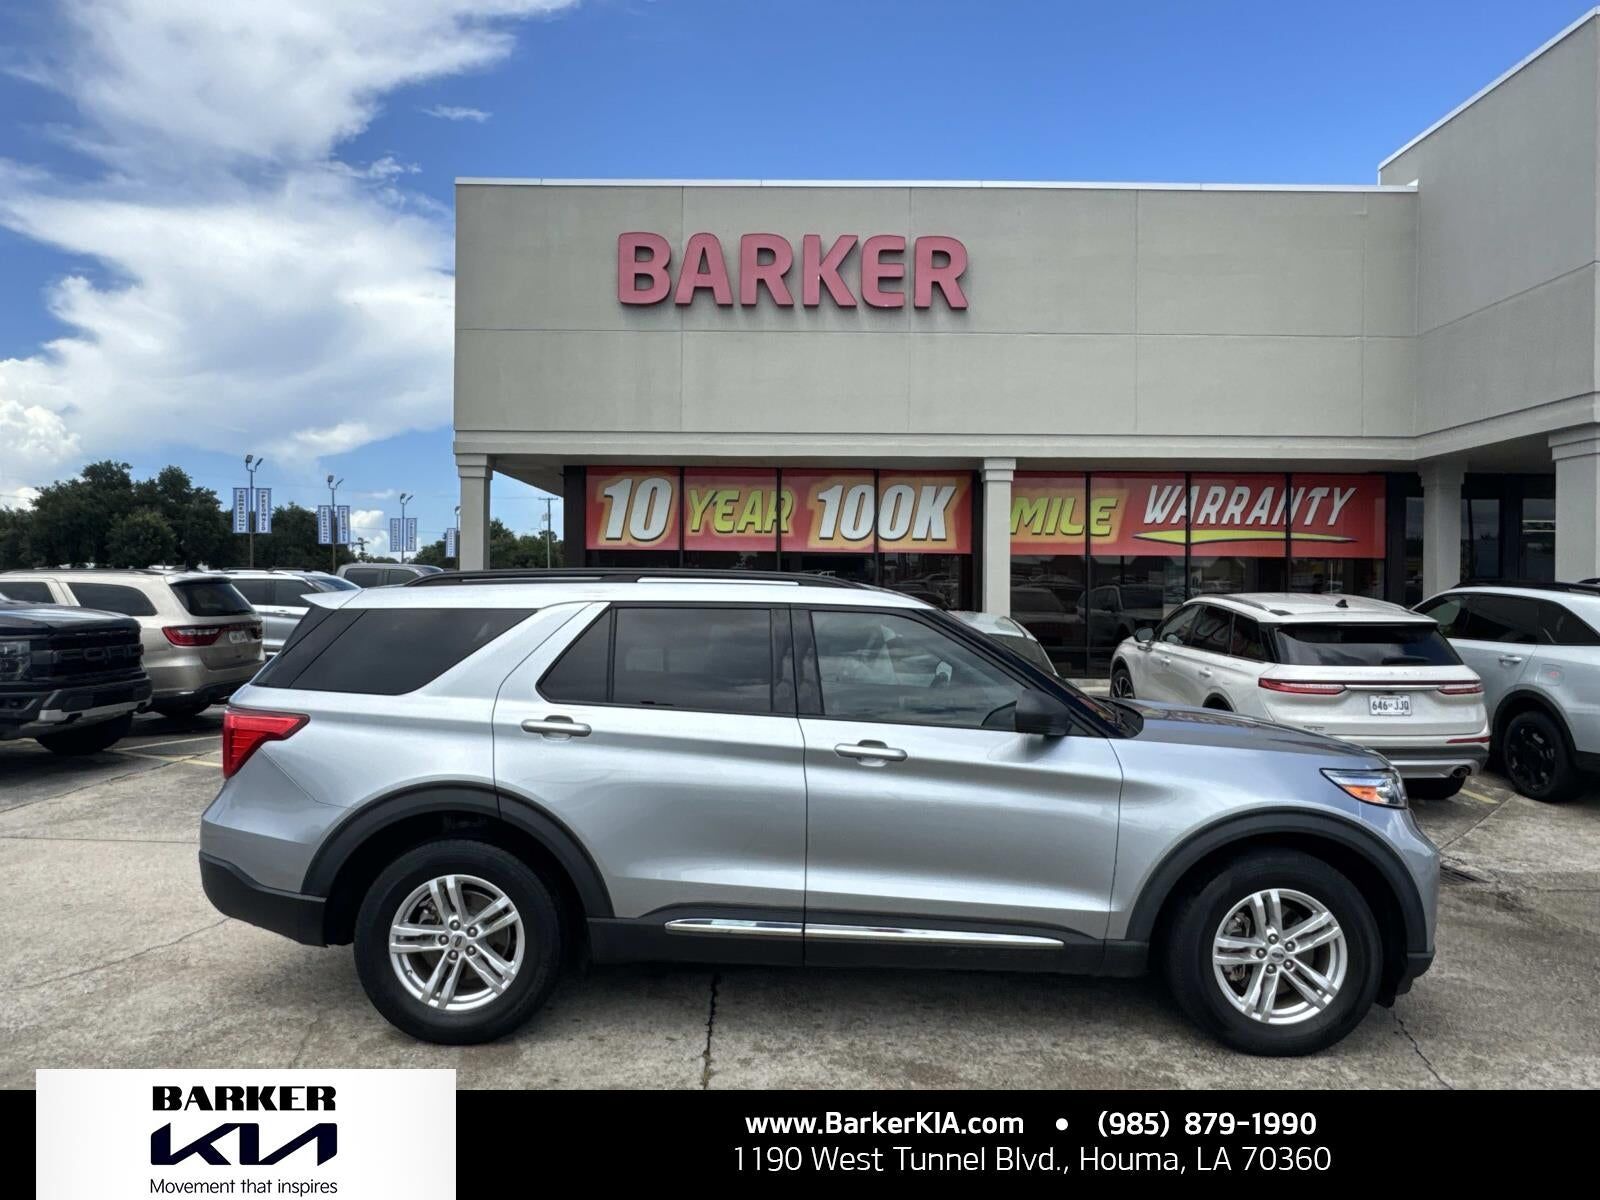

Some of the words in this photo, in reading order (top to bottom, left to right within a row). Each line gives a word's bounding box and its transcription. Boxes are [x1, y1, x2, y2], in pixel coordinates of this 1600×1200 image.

[618, 232, 969, 309] BARKER
[603, 477, 674, 543] 10
[688, 488, 794, 534] YEAR
[817, 484, 959, 542] 100K
[1010, 495, 1118, 537] MILE
[1143, 484, 1357, 526] WARRANTY
